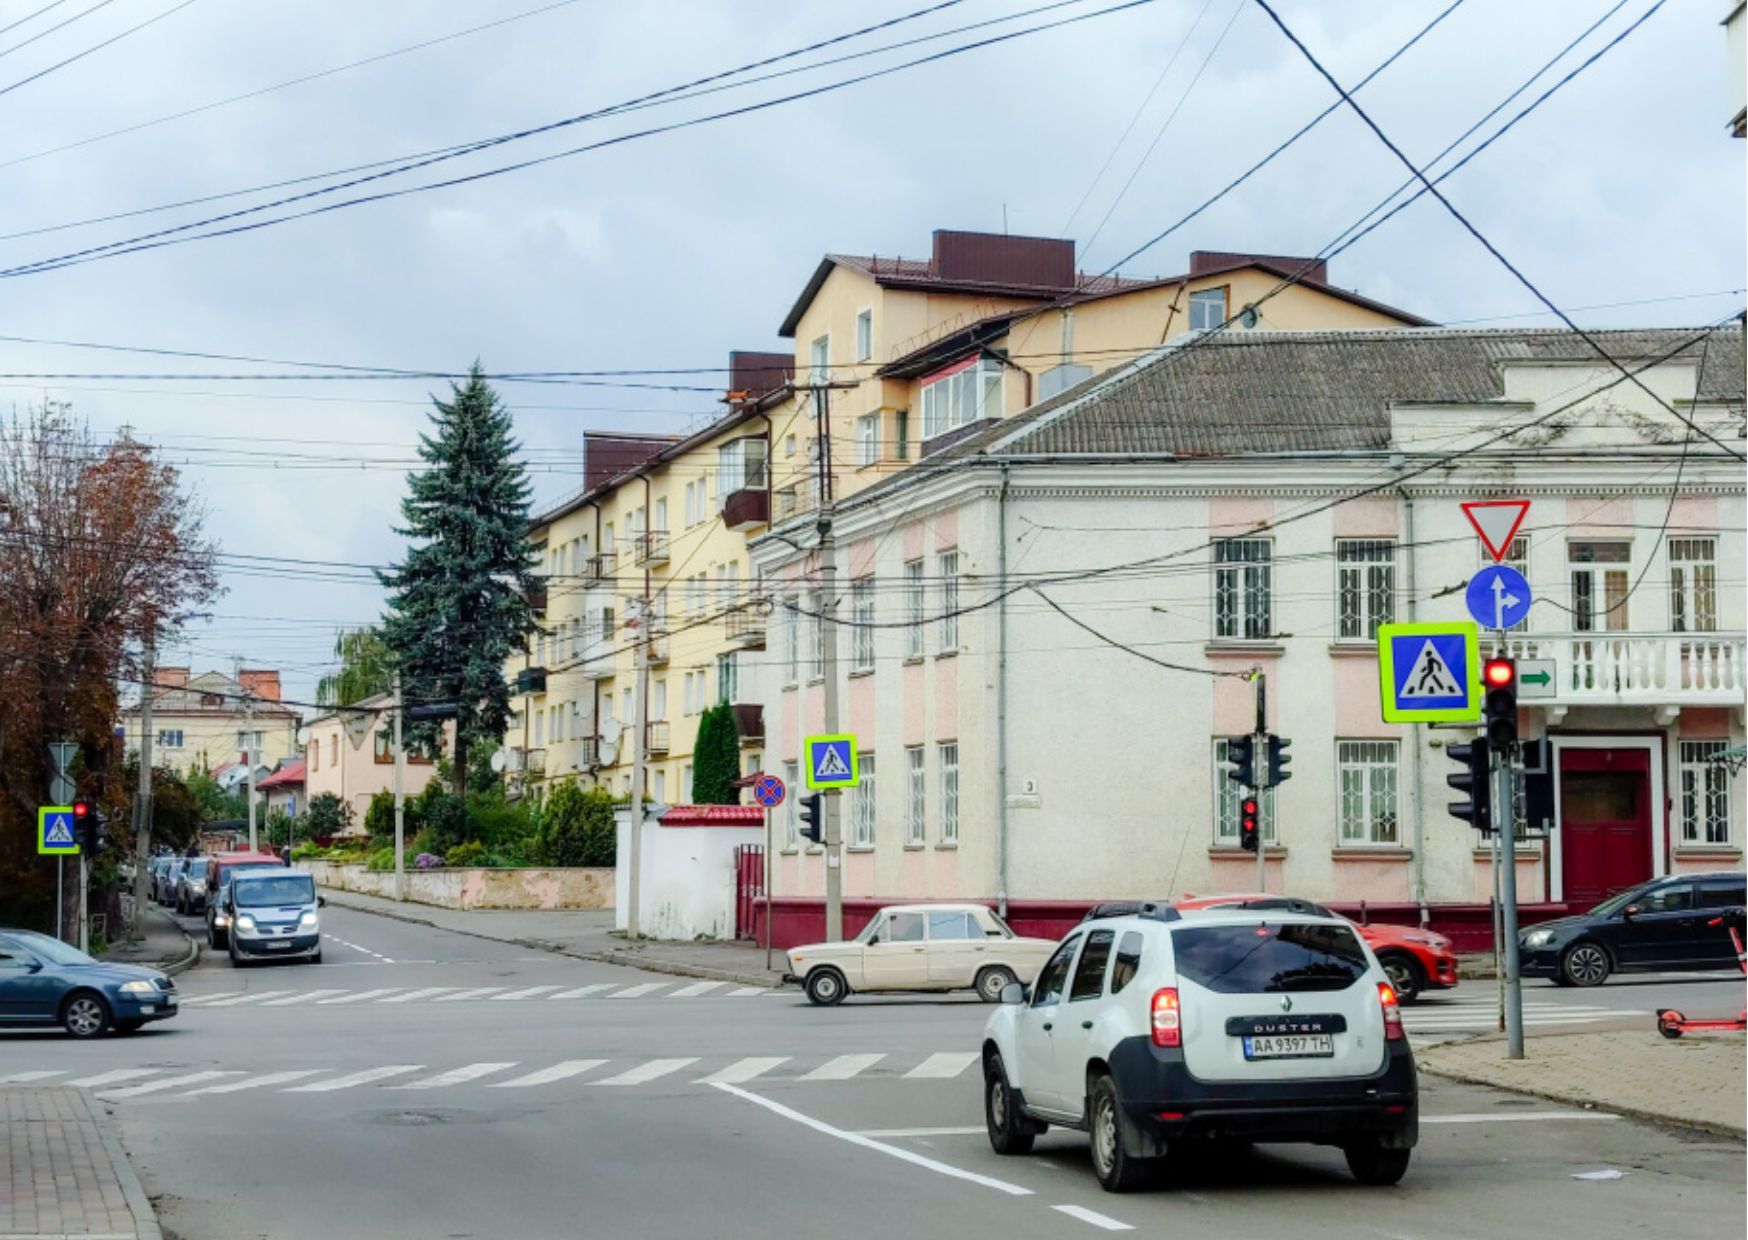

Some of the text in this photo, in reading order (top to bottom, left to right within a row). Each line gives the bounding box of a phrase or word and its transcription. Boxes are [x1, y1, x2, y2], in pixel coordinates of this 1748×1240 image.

[1253, 1023, 1322, 1033] DUSTER
[1254, 1036, 1330, 1053] AA 9397 TH
